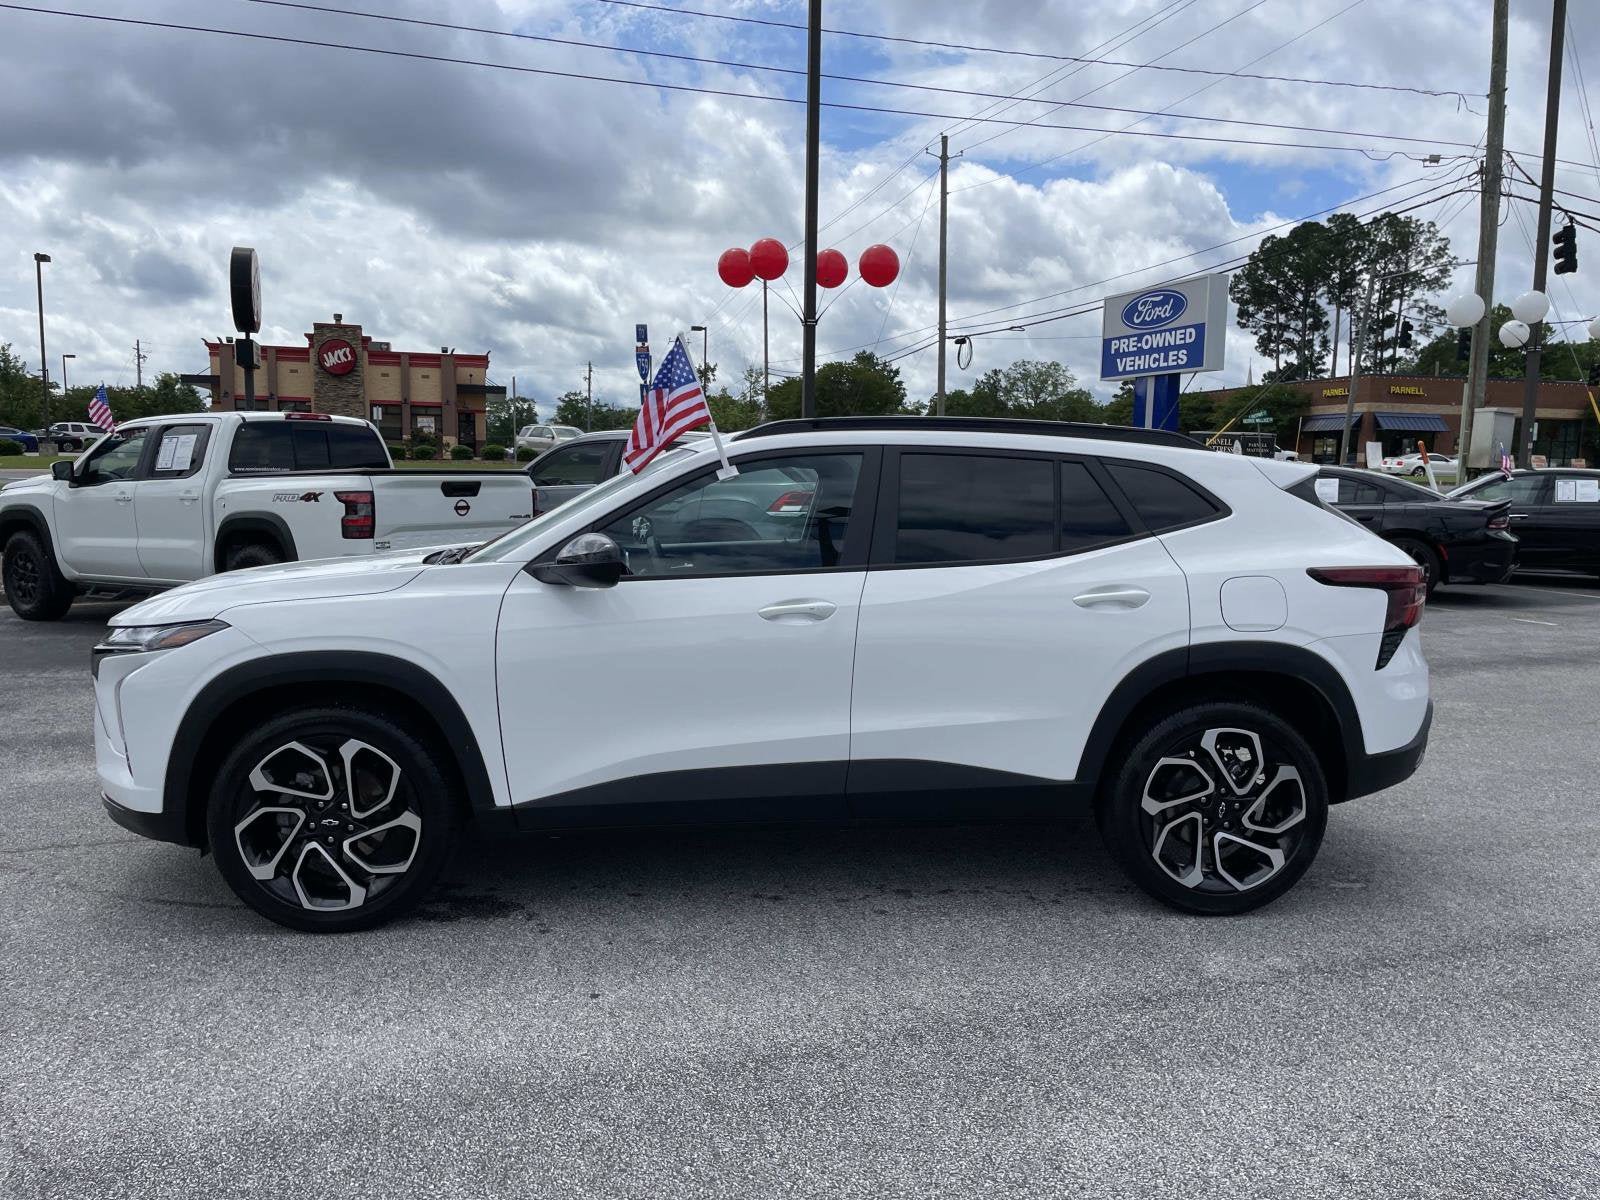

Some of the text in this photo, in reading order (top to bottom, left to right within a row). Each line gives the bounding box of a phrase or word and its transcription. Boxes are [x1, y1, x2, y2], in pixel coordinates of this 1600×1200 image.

[1133, 295, 1174, 324] Ford
[1110, 327, 1196, 355] PRE-OWNED
[1116, 349, 1188, 372] VEHICLES
[1322, 388, 1350, 398] PARNELL
[1390, 385, 1424, 395] PARNELL
